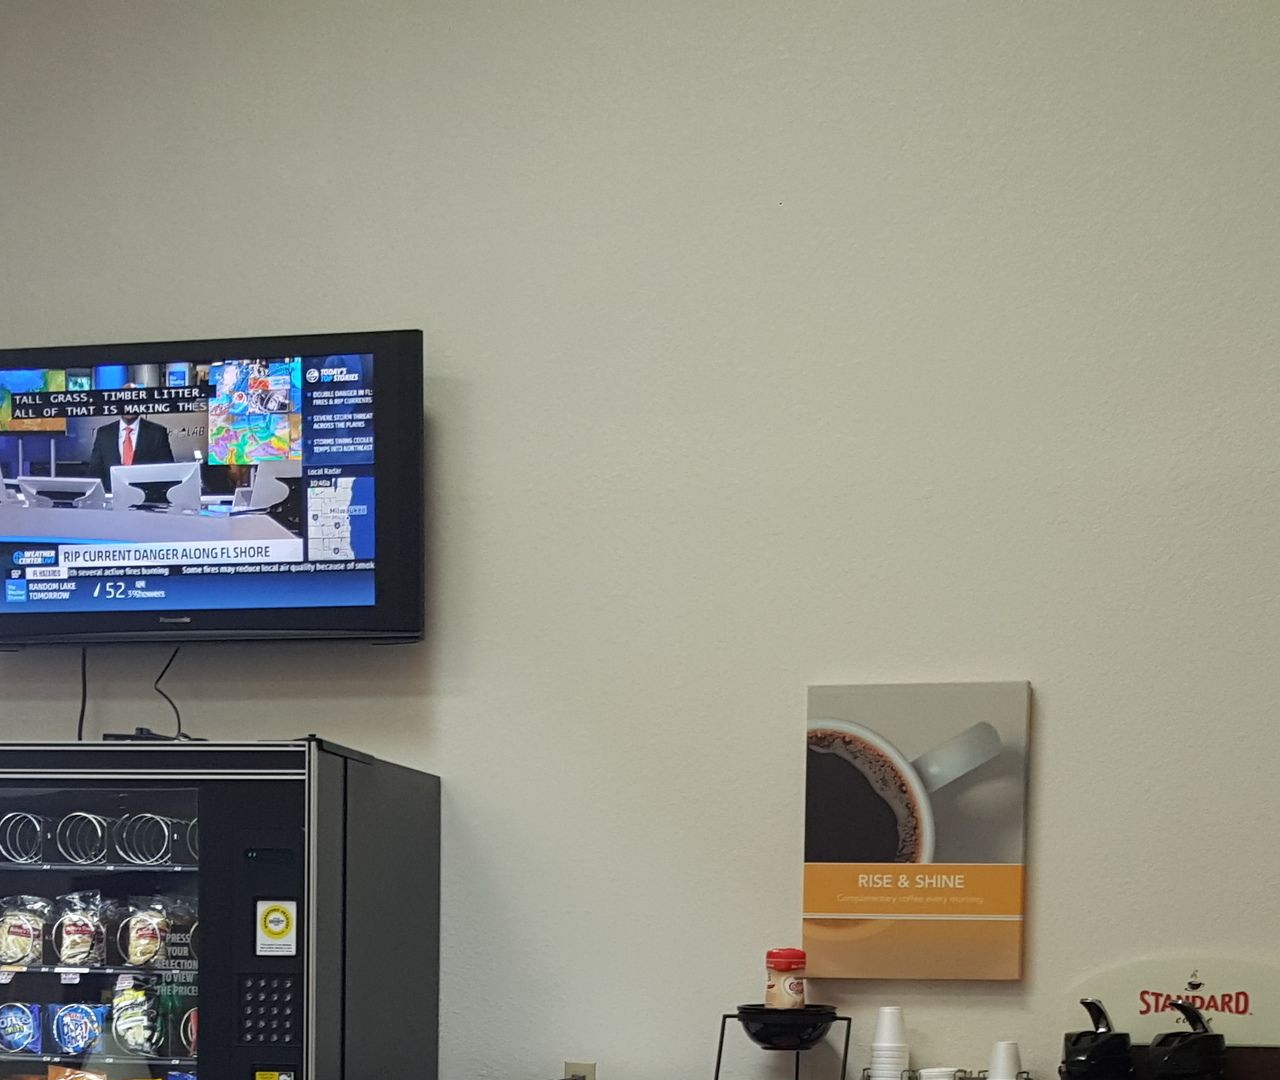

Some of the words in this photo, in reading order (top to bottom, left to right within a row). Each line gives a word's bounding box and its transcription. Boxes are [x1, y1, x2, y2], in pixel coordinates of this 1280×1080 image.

[14, 395, 42, 405] TALL
[50, 393, 93, 403] GRASS,
[102, 390, 147, 401] TIMBER
[154, 388, 206, 399] LITTER.
[14, 409, 36, 418] ALL
[43, 408, 57, 417] OF
[65, 406, 96, 416] THAT
[104, 405, 118, 415] IS
[124, 403, 171, 413] MAKING
[324, 467, 342, 475] Radar
[23, 551, 56, 559] WEATHER
[63, 551, 81, 563] RIP
[82, 550, 132, 563] CURRENT
[134, 549, 179, 561] DANGER
[180, 547, 218, 559] ALONG
[220, 547, 232, 559] FL
[233, 546, 271, 558] SHORE
[78, 568, 103, 577] several
[104, 567, 124, 576] active
[125, 567, 140, 576] fires
[141, 567, 170, 577] burning
[182, 566, 202, 575] Some
[203, 565, 219, 574] fires
[220, 566, 235, 575] may
[236, 564, 261, 573] reduce
[261, 564, 279, 573] local
[279, 563, 289, 572] air
[290, 563, 315, 573] quality
[316, 562, 345, 571] because
[346, 562, 355, 570] of
[29, 583, 60, 591] RANDOM
[60, 582, 77, 590] LAKE
[106, 582, 125, 598] 52
[29, 591, 70, 600] TOMORROW
[858, 874, 893, 888] RISE
[897, 875, 910, 888] &
[914, 874, 966, 889] SHINE
[836, 893, 897, 905] Complimentary
[899, 893, 924, 903] coffee
[925, 896, 947, 905] every
[948, 896, 985, 905] morning
[165, 933, 191, 943] PRESS
[166, 946, 189, 956] YOUR
[155, 959, 199, 969] SELECTION
[162, 972, 172, 982] TO
[172, 972, 194, 983] VIEW
[153, 985, 172, 996] THE
[1139, 990, 1250, 1015] STANDARD
